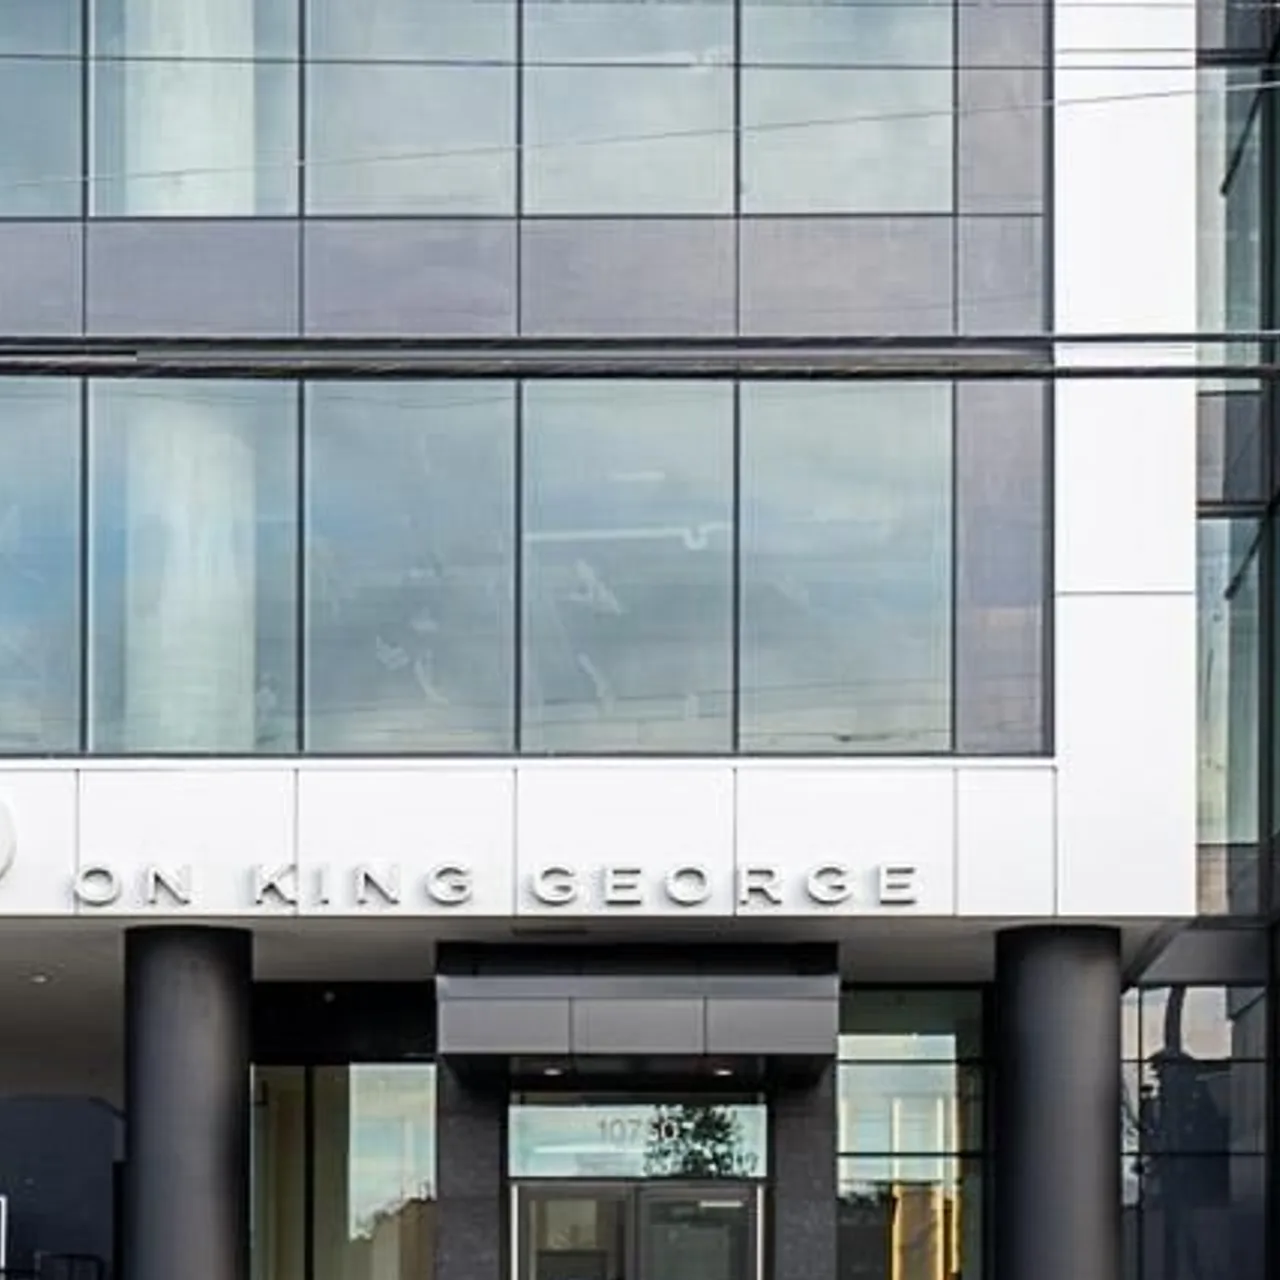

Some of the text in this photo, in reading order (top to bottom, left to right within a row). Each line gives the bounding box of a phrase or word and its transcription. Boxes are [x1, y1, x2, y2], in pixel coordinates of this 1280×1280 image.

[72, 865, 194, 906] ON
[252, 865, 475, 906] KING
[530, 865, 919, 906] GEORGE
